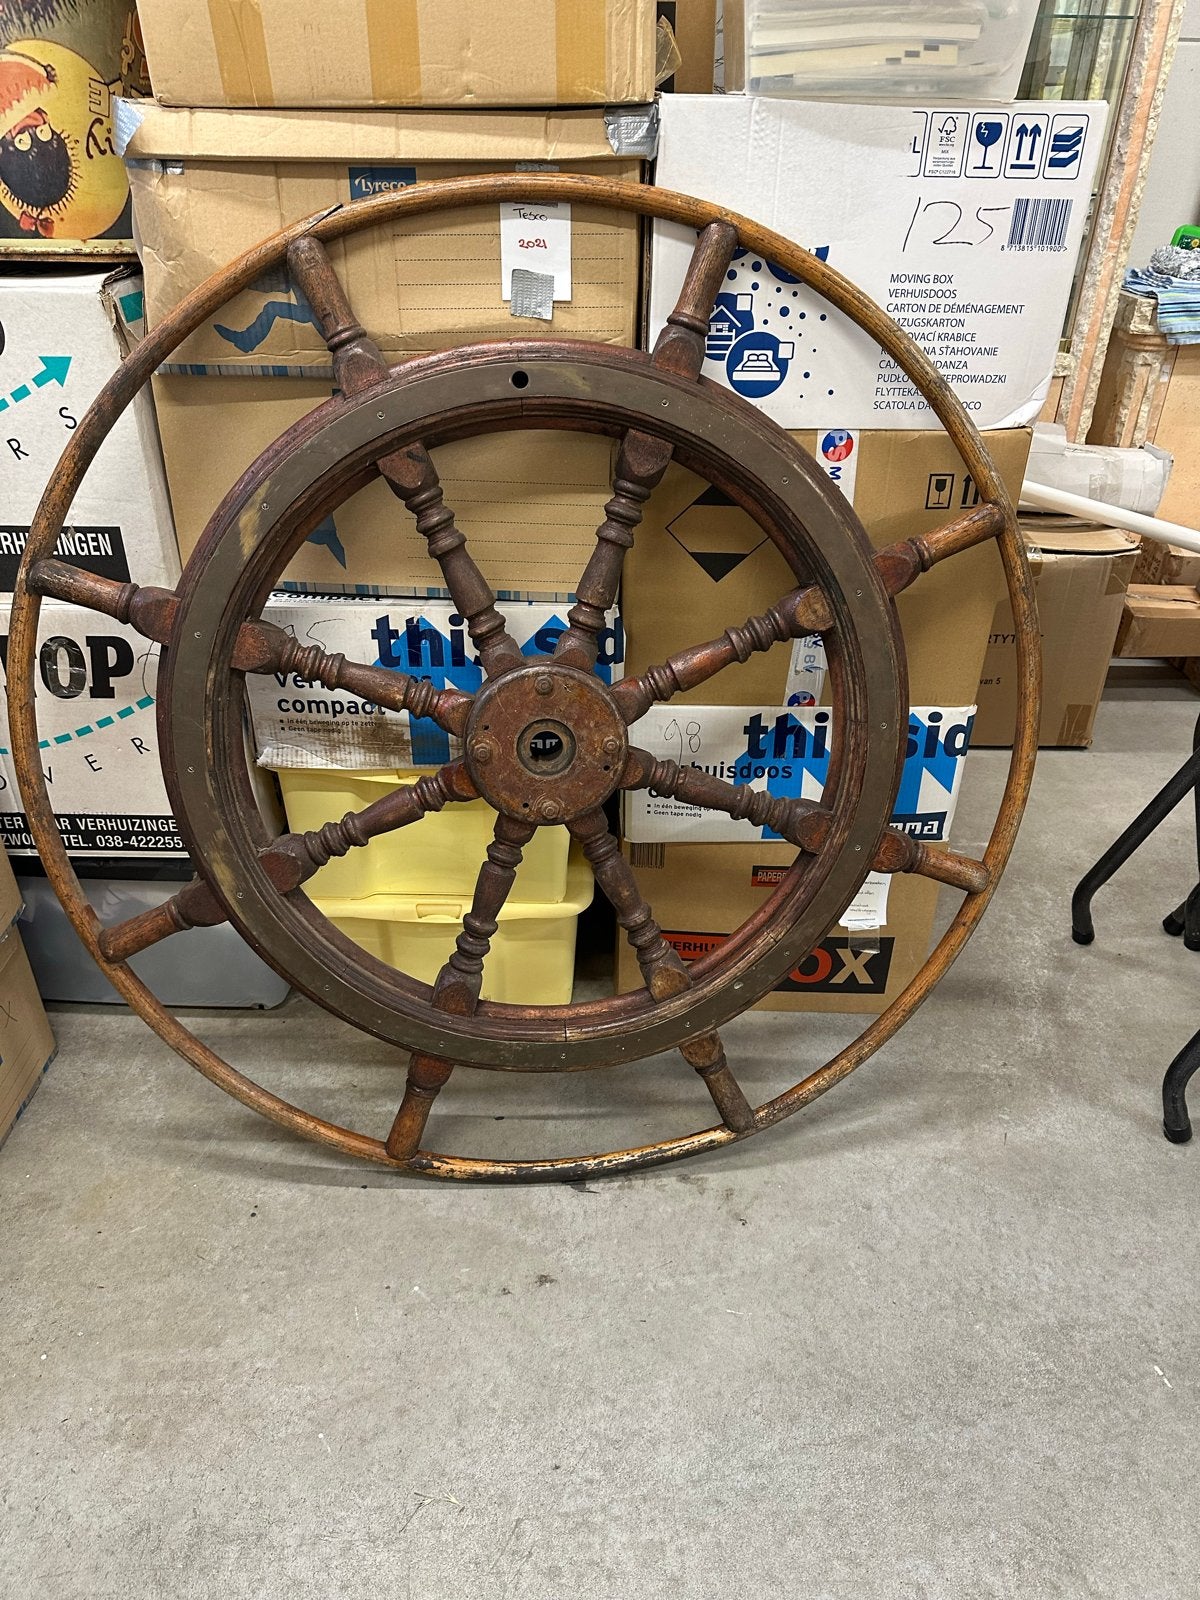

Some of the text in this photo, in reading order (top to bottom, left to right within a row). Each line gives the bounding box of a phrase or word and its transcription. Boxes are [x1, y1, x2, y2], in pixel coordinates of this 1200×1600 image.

[361, 180, 408, 197] Lyreco
[513, 208, 548, 222] Tesco
[903, 197, 1011, 253] 125
[518, 238, 548, 249] 2021
[890, 273, 954, 284] MOVING BOX
[888, 288, 957, 299] VERHUISDOOS
[886, 302, 1025, 314] CARTON DE DÉMÉNAGEMENT
[893, 317, 965, 327] ZUGSKARTON
[907, 331, 977, 343] OVACÍ KRABICE
[938, 344, 999, 356] SŤAHOVANIE
[932, 360, 968, 370] DANZA
[942, 374, 1007, 384] EPROWADZKI
[875, 387, 923, 397] FLYTTEKA
[873, 400, 915, 410] SCATOLA
[370, 614, 484, 667] thi
[0, 635, 134, 699] OP
[996, 677, 1001, 685] 5
[277, 698, 386, 719] compact
[743, 711, 830, 759] thi
[664, 719, 701, 766] 98
[674, 804, 702, 812] beweging
[76, 818, 179, 832] VERHUIZINGE
[1, 833, 184, 848] ZWOL TEL. 038-422255
[669, 940, 716, 952] ERHU
[789, 946, 875, 985] OX
